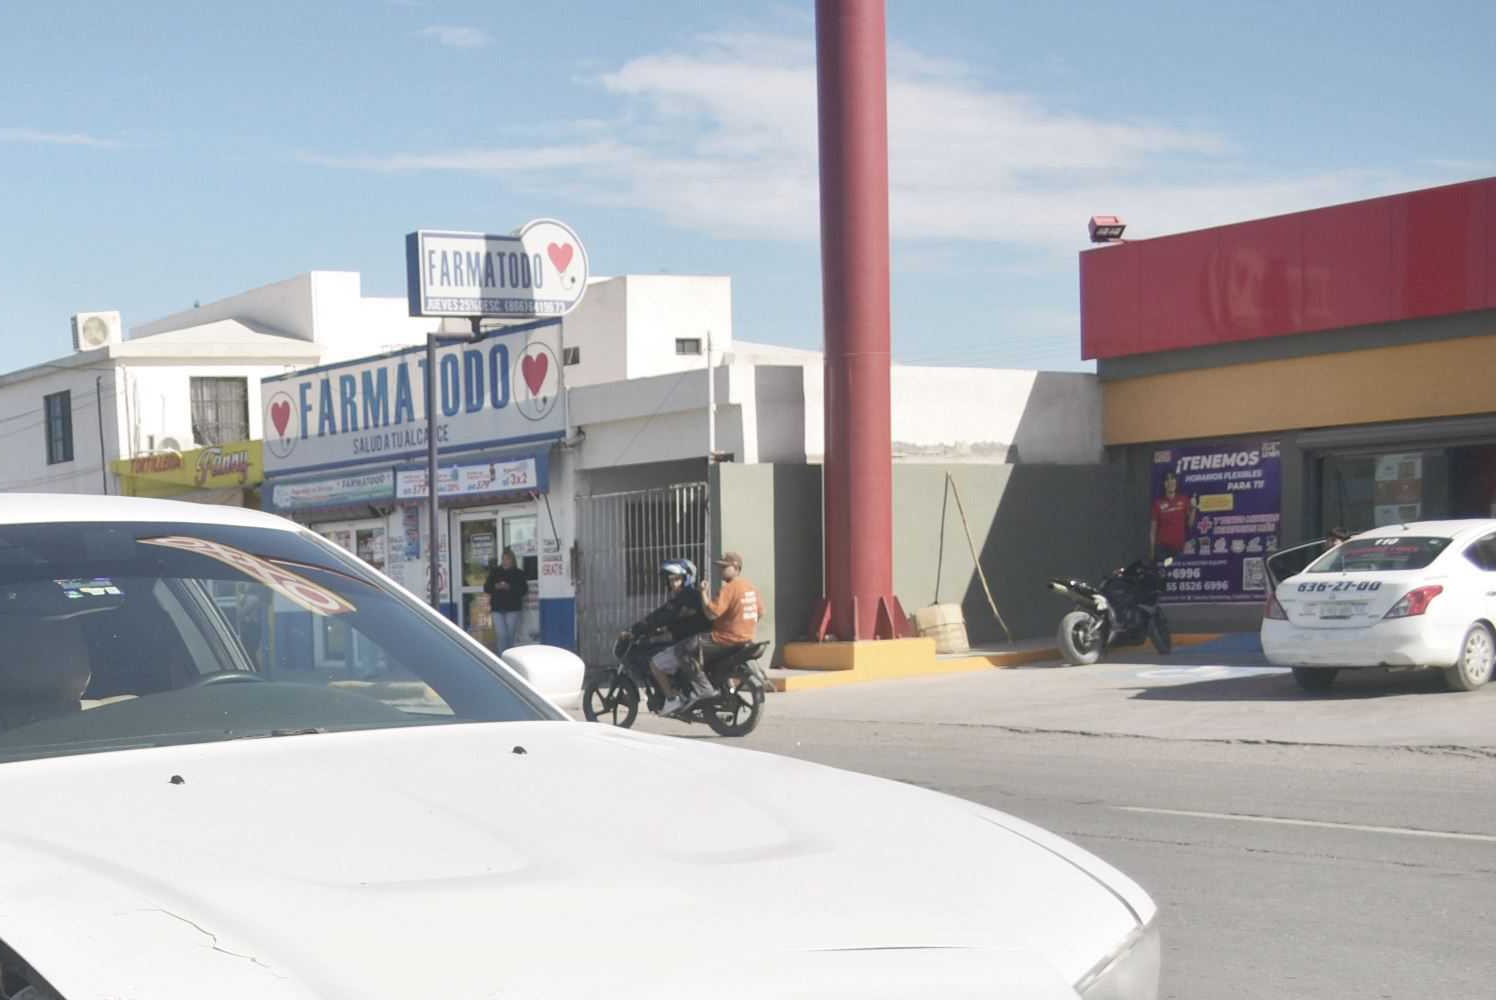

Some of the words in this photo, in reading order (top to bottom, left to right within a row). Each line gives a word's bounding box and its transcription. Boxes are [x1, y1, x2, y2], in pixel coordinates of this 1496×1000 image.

[428, 249, 543, 289] FARMATODO
[299, 344, 509, 440] FARMATODO
[353, 434, 383, 454] SALUD
[392, 431, 404, 448] TU
[405, 424, 449, 447] ALCACE
[1176, 451, 1260, 474] ¡TENEMOS
[1227, 481, 1251, 490] PARA
[1297, 581, 1382, 593] 636-27-00
